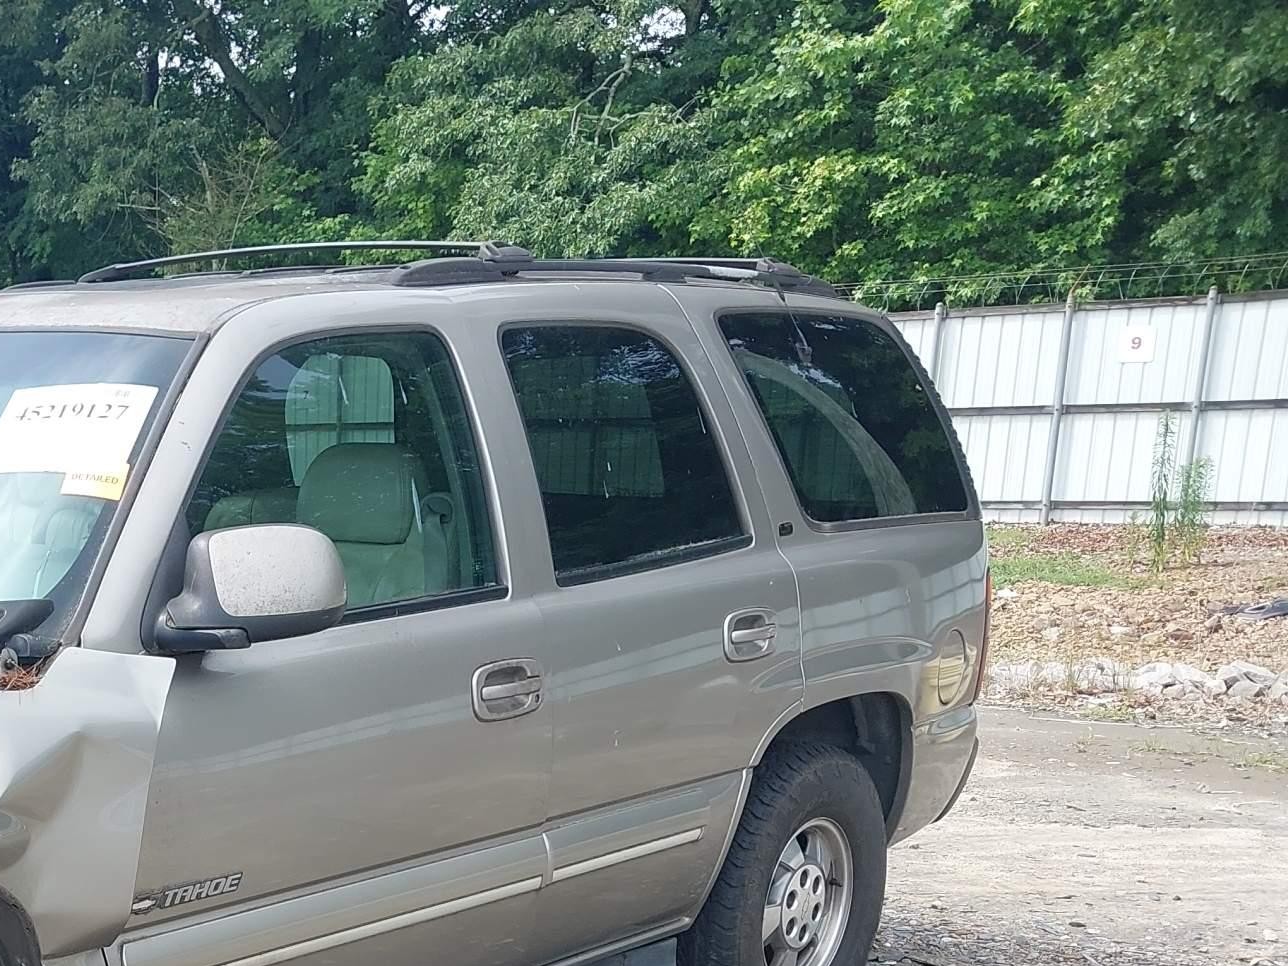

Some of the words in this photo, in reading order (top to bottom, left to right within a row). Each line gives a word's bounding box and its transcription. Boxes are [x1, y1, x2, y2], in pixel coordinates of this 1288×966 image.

[1130, 336, 1143, 350] 9
[15, 403, 130, 421] 45219127
[163, 872, 243, 908] TAHOE
